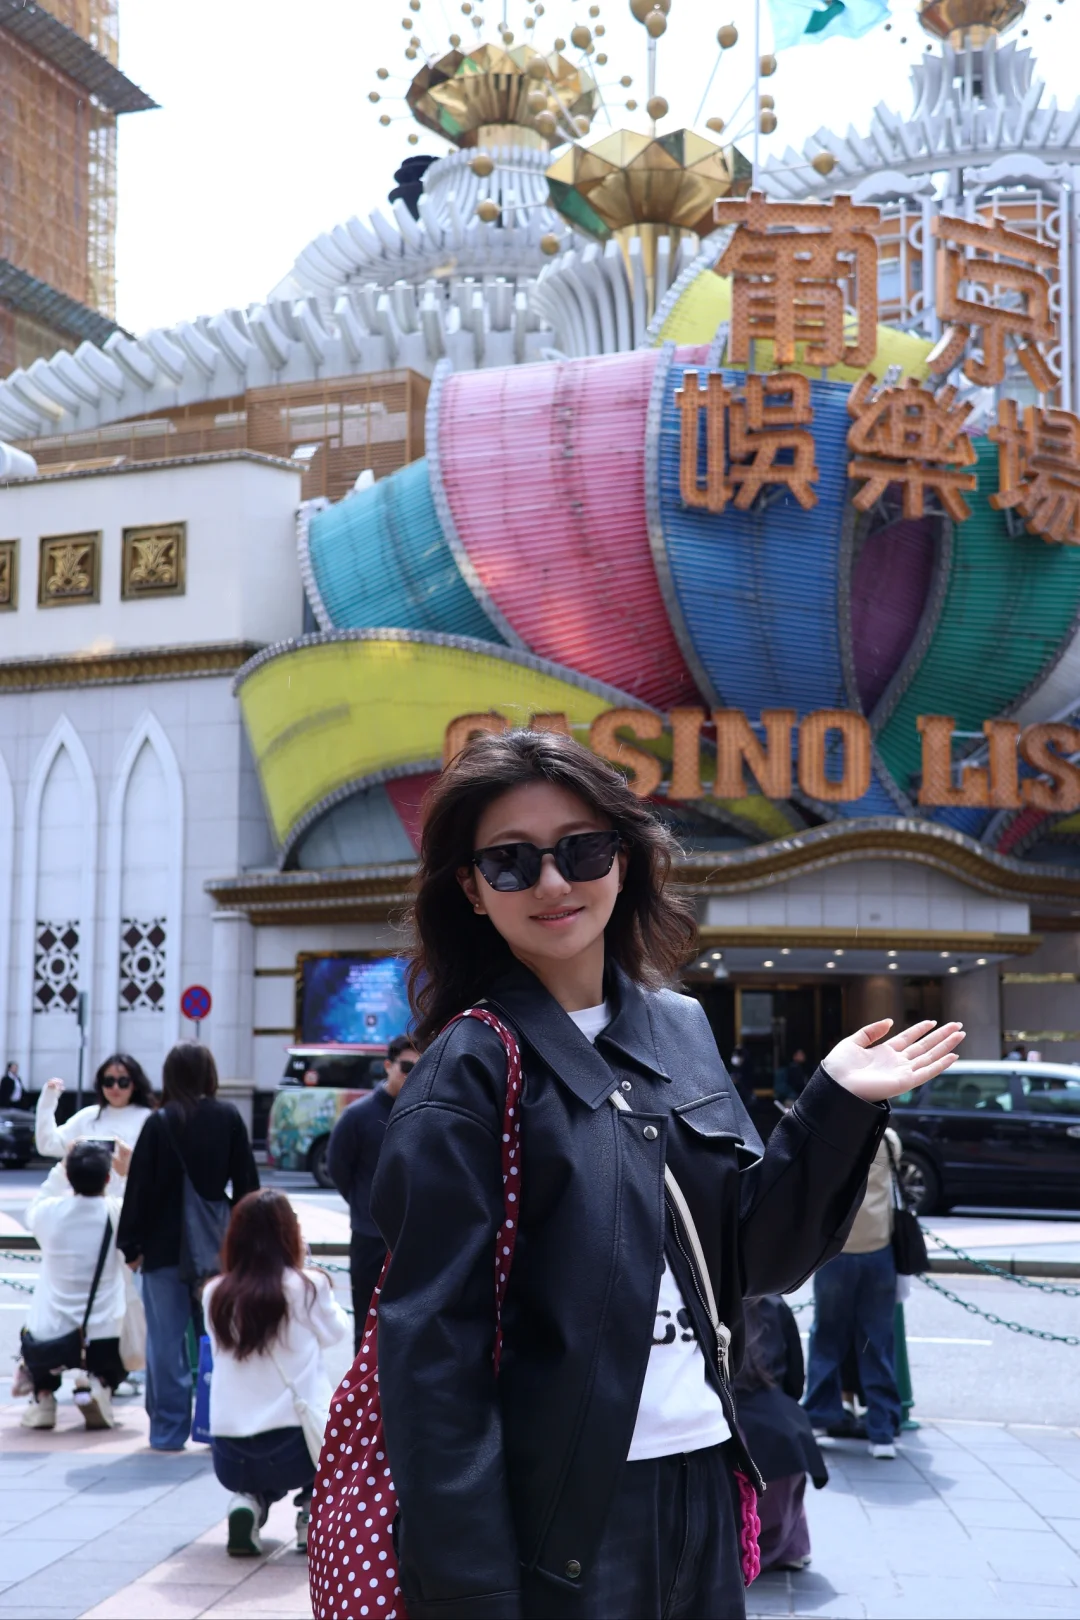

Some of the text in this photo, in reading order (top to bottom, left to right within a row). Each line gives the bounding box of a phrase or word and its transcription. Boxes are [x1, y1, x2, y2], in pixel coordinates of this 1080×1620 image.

[714, 191, 1059, 391] 葡京
[445, 708, 1080, 813] SINO LIS
